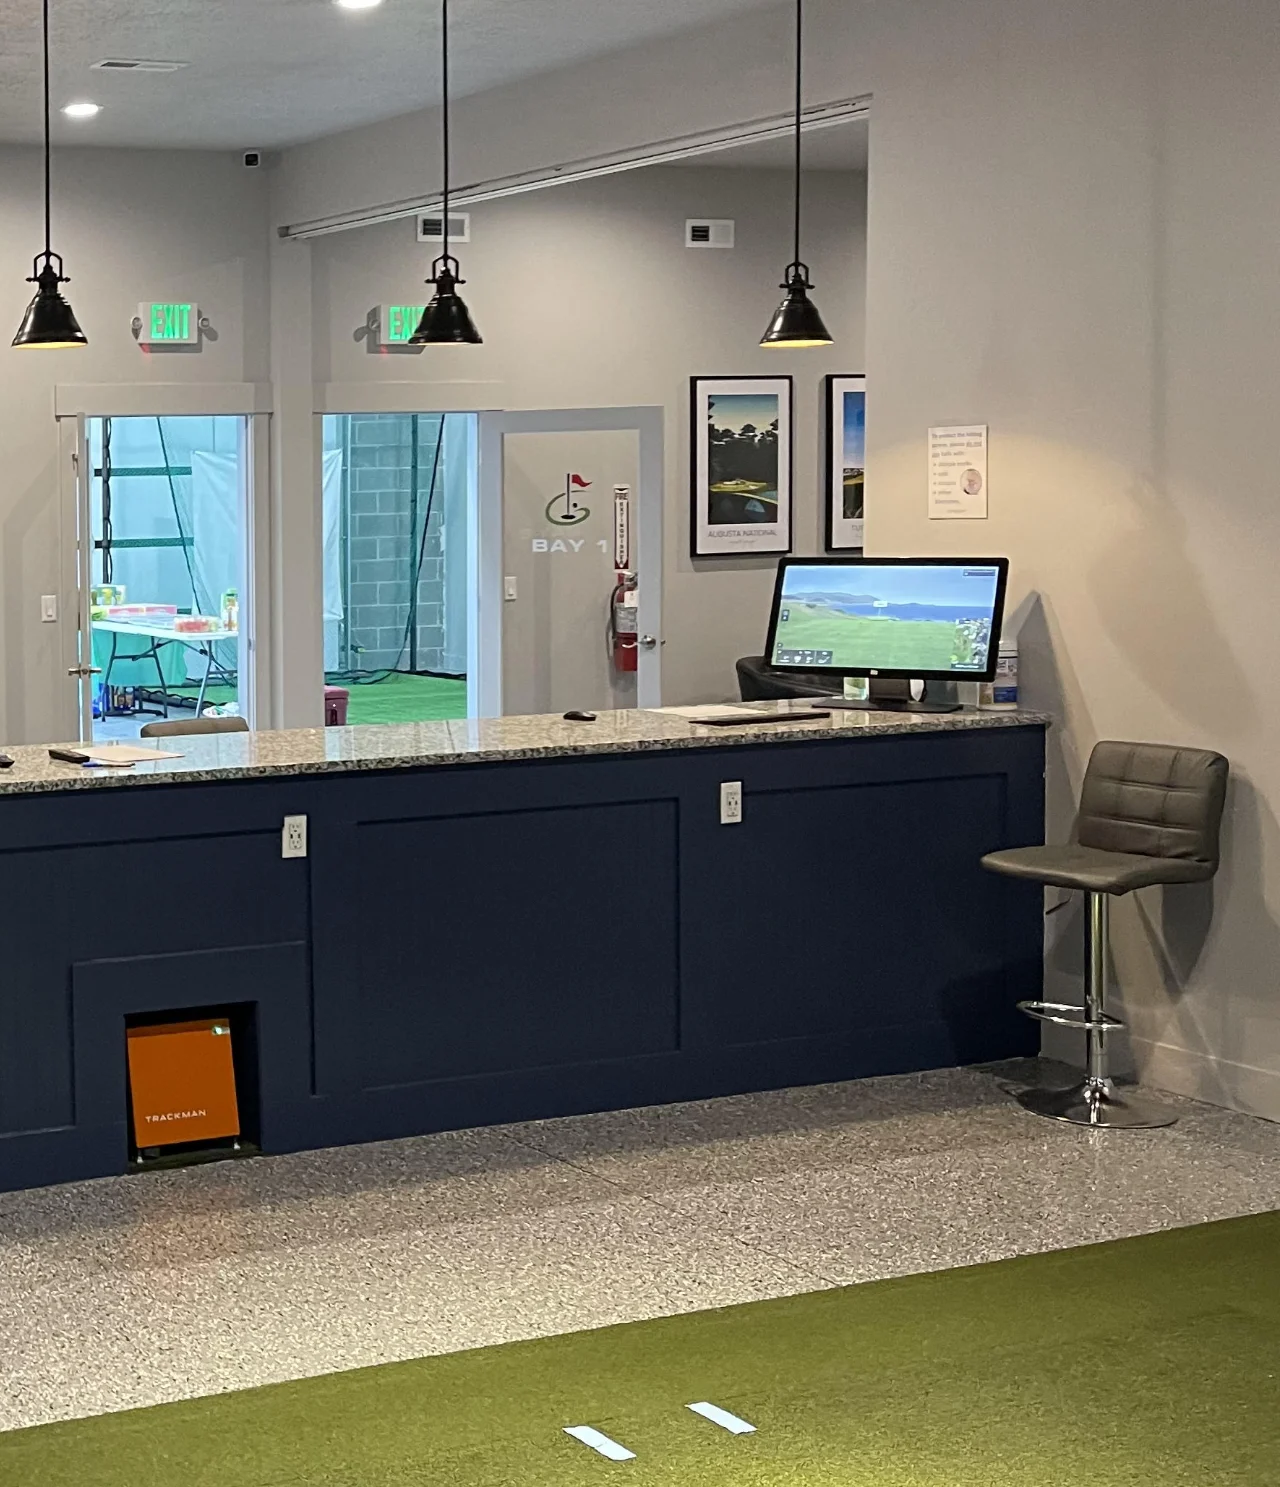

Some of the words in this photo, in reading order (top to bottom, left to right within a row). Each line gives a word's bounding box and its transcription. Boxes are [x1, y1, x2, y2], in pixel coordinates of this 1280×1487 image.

[151, 304, 191, 339] EXIT
[707, 529, 741, 538] AUGUSTA
[532, 539, 585, 553] BAY
[596, 539, 608, 553] 1
[145, 1109, 207, 1123] TRACKMAN
